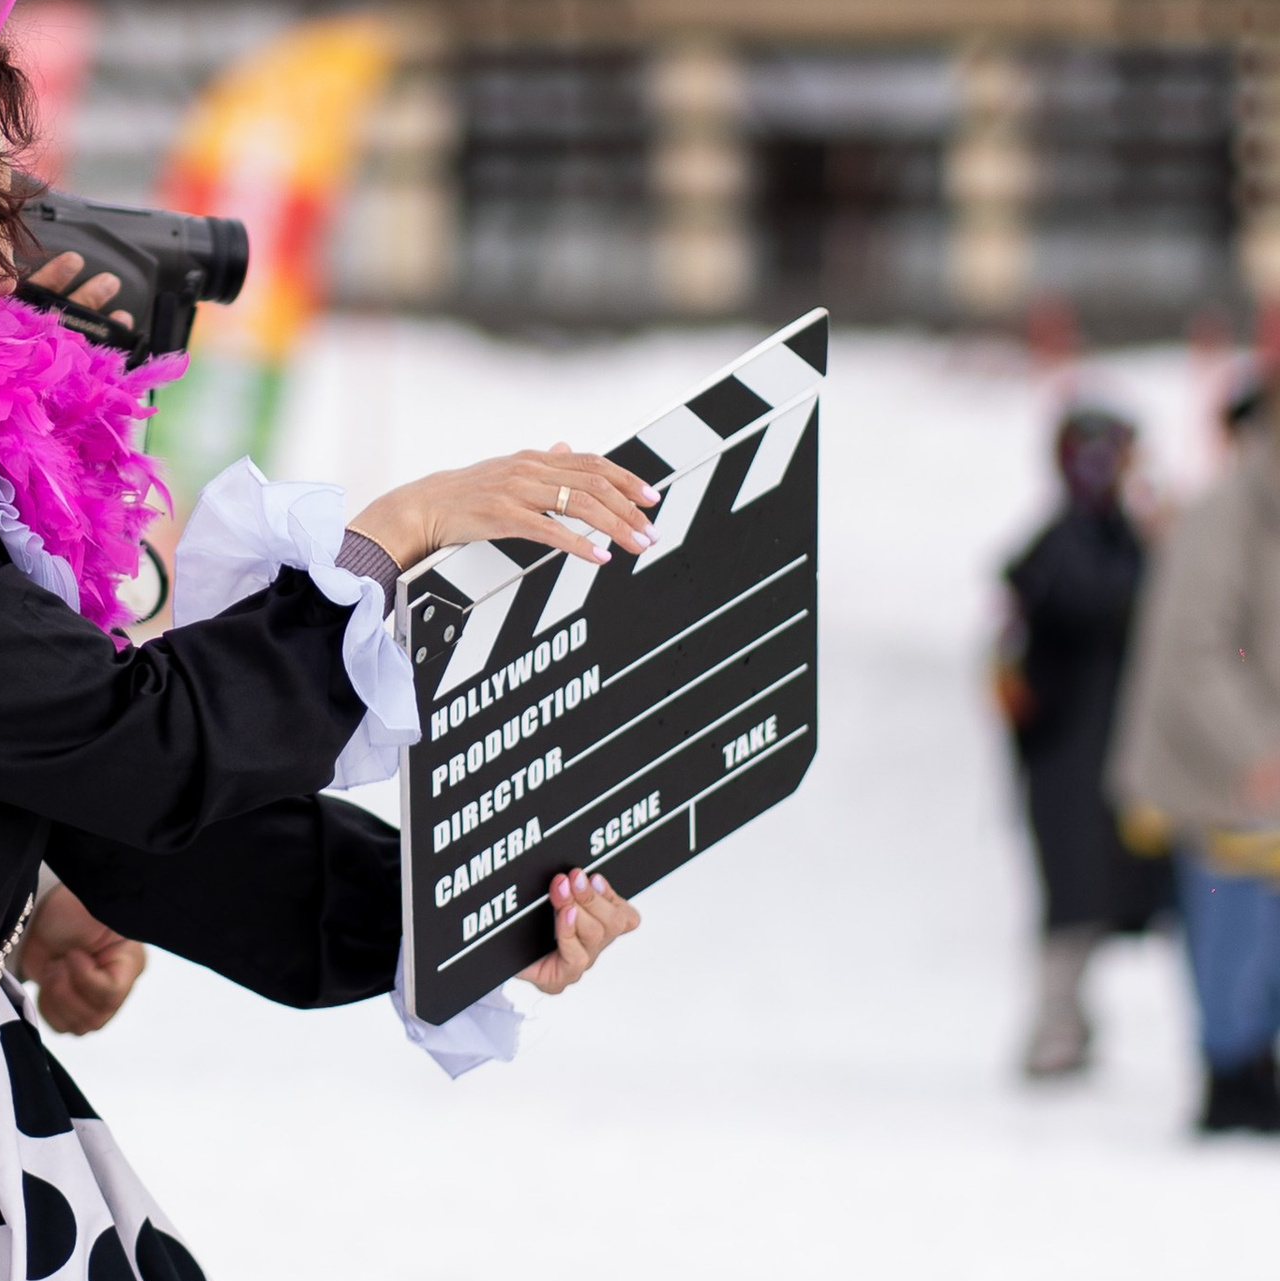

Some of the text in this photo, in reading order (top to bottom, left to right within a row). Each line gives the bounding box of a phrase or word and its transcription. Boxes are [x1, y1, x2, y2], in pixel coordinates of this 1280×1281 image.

[431, 618, 587, 742] HOLLYWOOD
[432, 664, 600, 798] PRODUCTION
[433, 746, 562, 854] DIRECTOR
[435, 816, 542, 908] CAMERA
[462, 714, 778, 941] DATE SCENE TAKE
